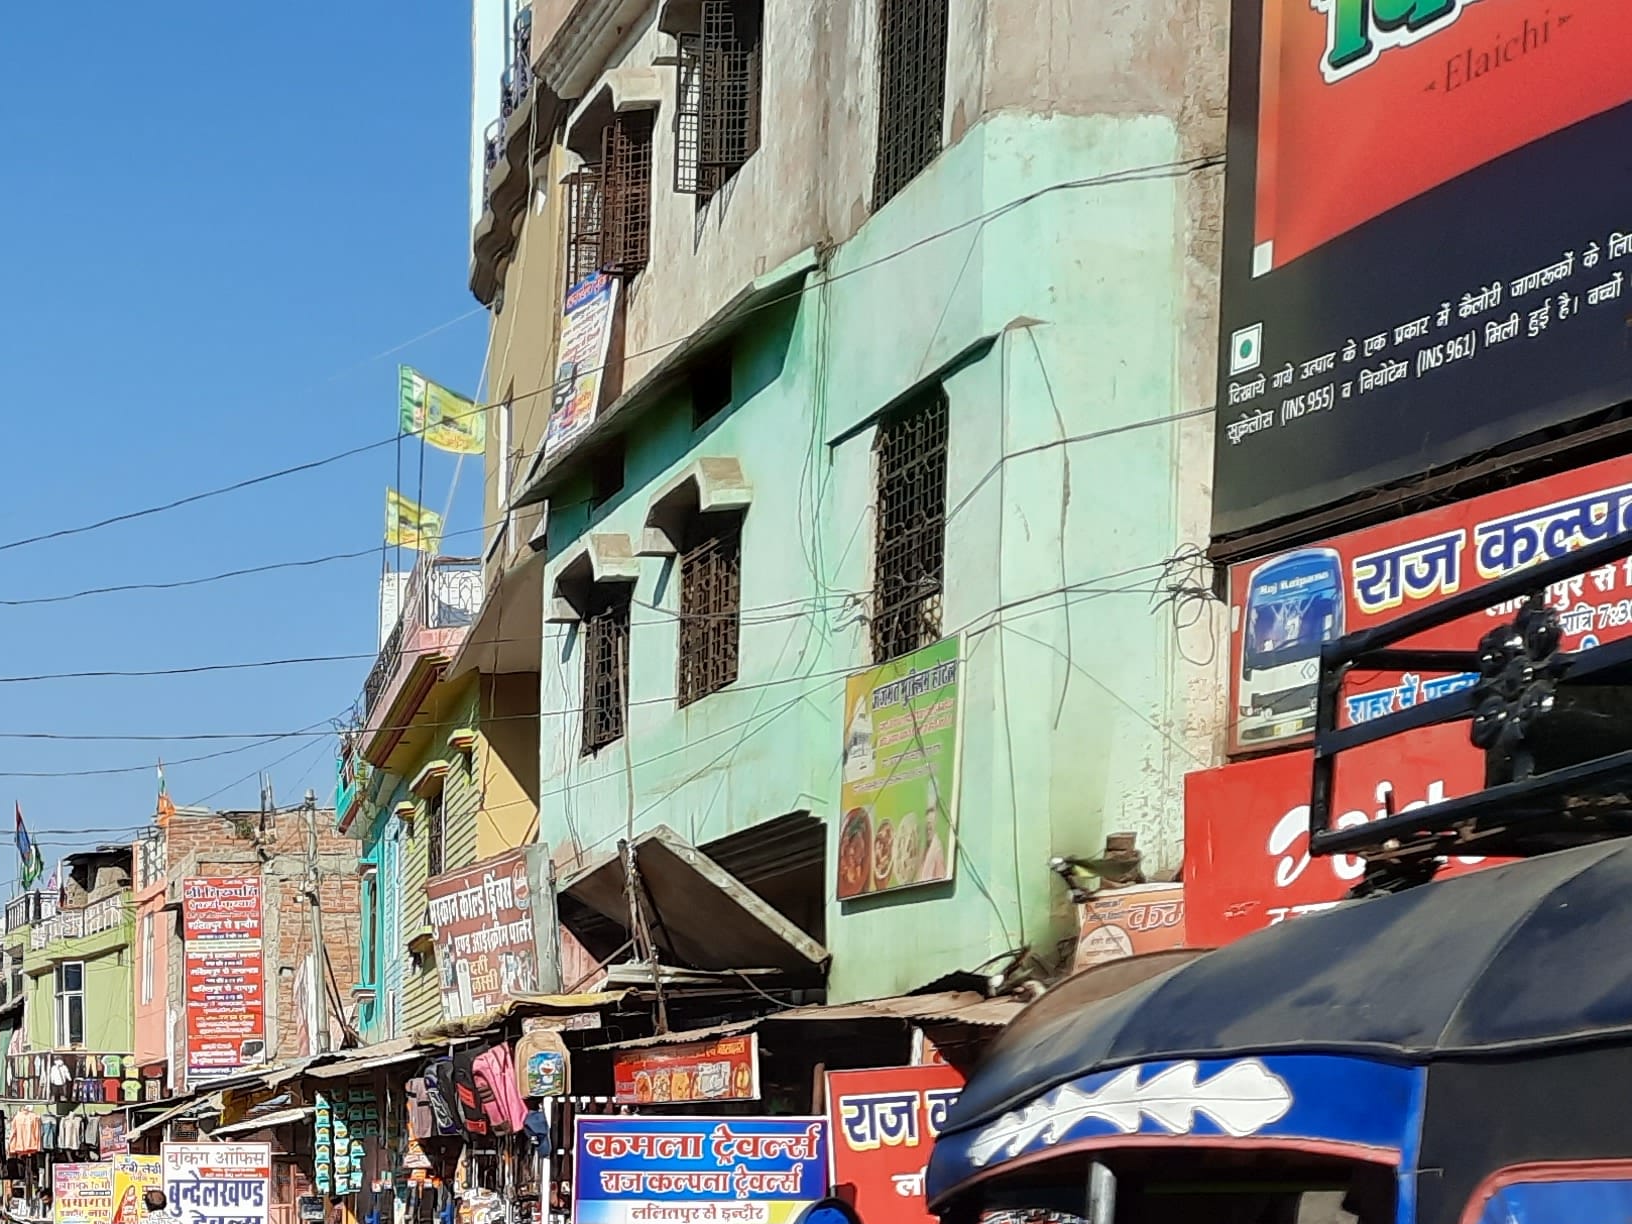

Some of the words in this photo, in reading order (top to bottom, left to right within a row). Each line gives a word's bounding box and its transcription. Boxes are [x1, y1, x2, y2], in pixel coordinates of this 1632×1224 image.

[1444, 9, 1551, 92] Elaichi
[1228, 373, 1266, 405] दिखाये
[1272, 362, 1294, 388] गये
[1299, 351, 1337, 379] उत्पाद
[1342, 338, 1357, 362] के
[1363, 332, 1388, 356] एक
[1393, 315, 1430, 345] प्रकार
[1436, 302, 1451, 327] में
[1458, 281, 1503, 318] कैलोरी
[1583, 242, 1600, 267] के
[1341, 381, 1353, 398] व
[1484, 312, 1520, 347] मिली
[1527, 298, 1551, 337] हुई
[1353, 529, 1465, 612] राज
[1345, 688, 1395, 724] शहर
[841, 1091, 920, 1150] राज
[167, 1146, 211, 1171] बुकिंग
[214, 1146, 265, 1167] ऑफिस
[585, 1132, 704, 1160] कमला
[167, 1169, 266, 1217] बुन्देलखण्ड
[600, 1170, 644, 1193] राज
[647, 1170, 729, 1194] कल्पना
[631, 1202, 699, 1223] ललितपुर
[703, 1202, 717, 1218] से
